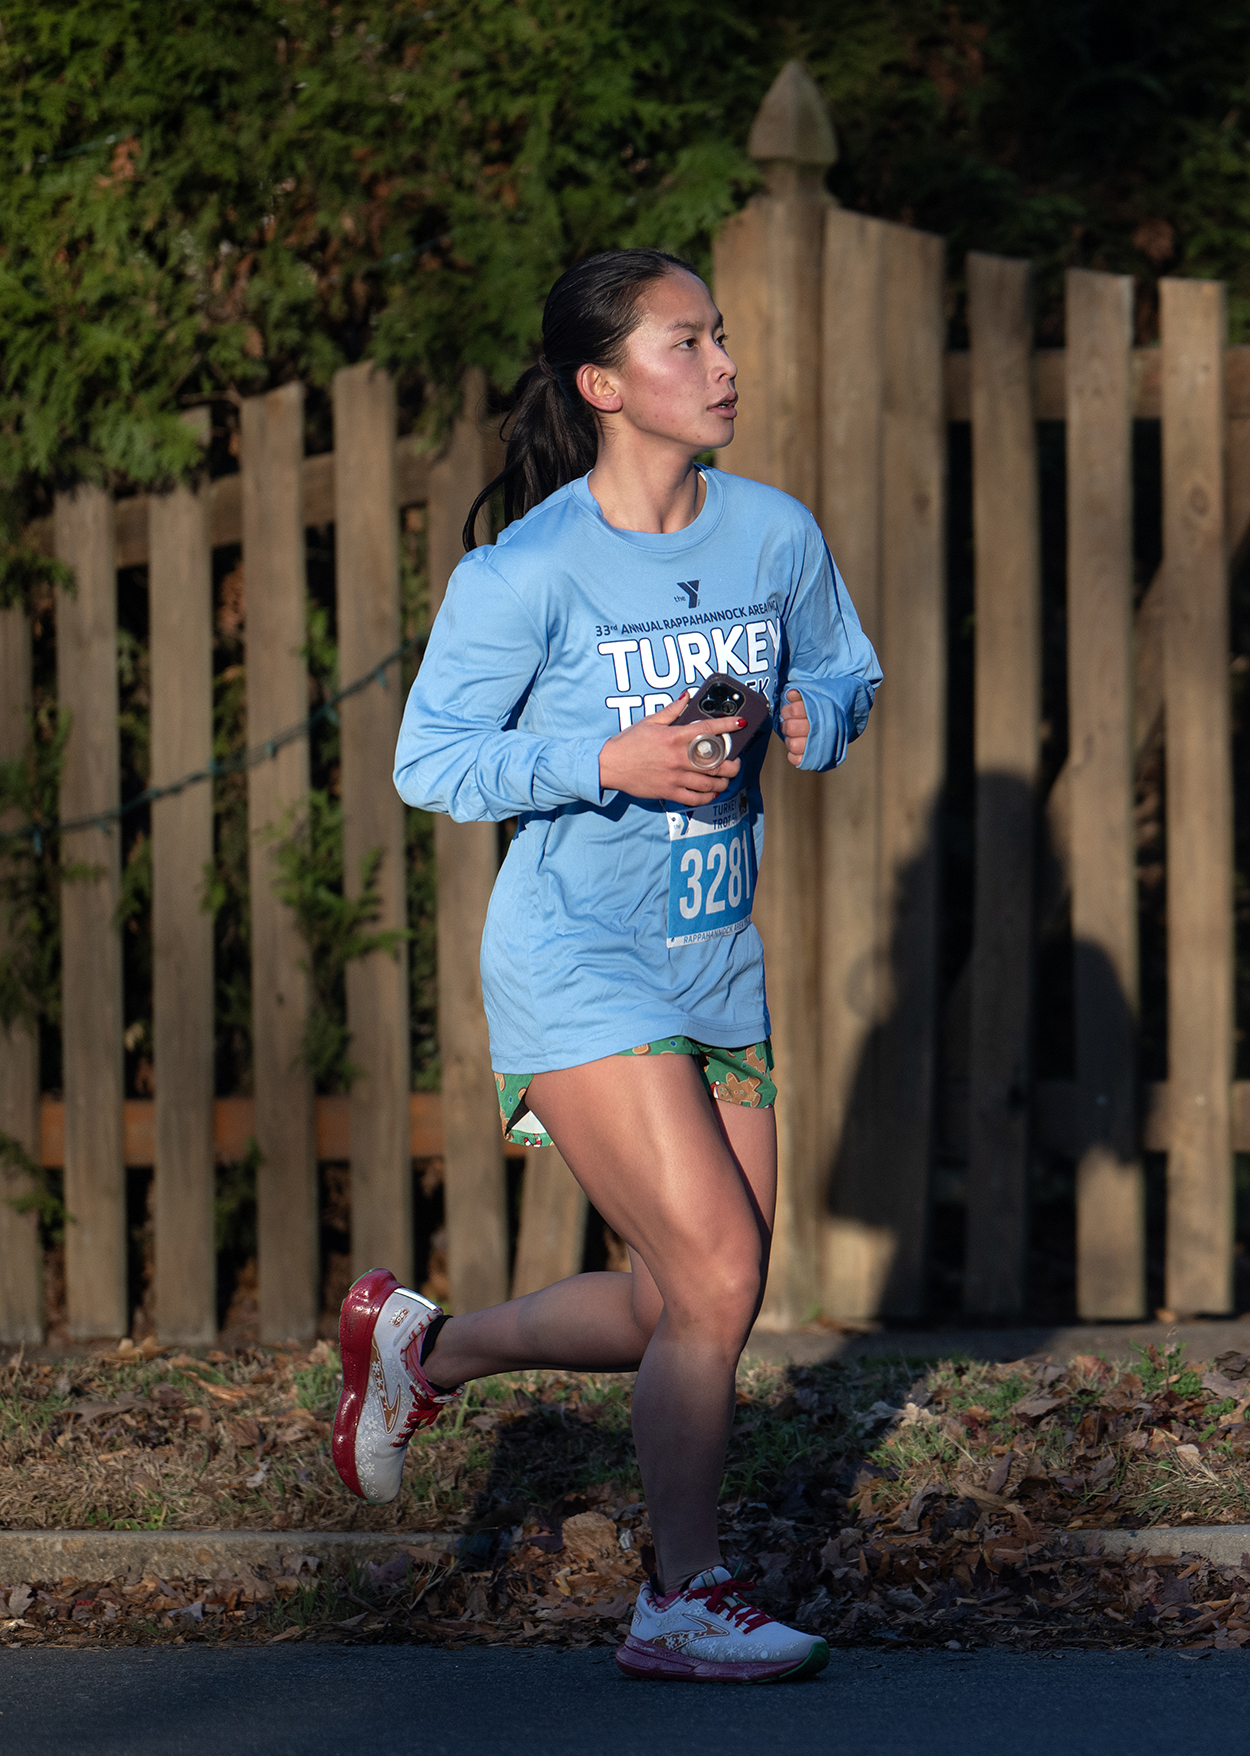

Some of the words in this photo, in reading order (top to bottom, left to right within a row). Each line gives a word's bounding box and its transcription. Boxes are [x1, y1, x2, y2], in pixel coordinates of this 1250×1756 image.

[674, 595, 687, 603] the
[676, 579, 700, 609] Y
[595, 623, 619, 637] 33rd
[621, 619, 663, 635] ANNUAL
[662, 606, 748, 629] RAPPAHANNOCK
[748, 602, 768, 617] AREA
[597, 617, 782, 693] TURKEY
[712, 815, 731, 831] TROT
[679, 830, 751, 920] 3281
[683, 925, 733, 944] RAPPAHANNOCK
